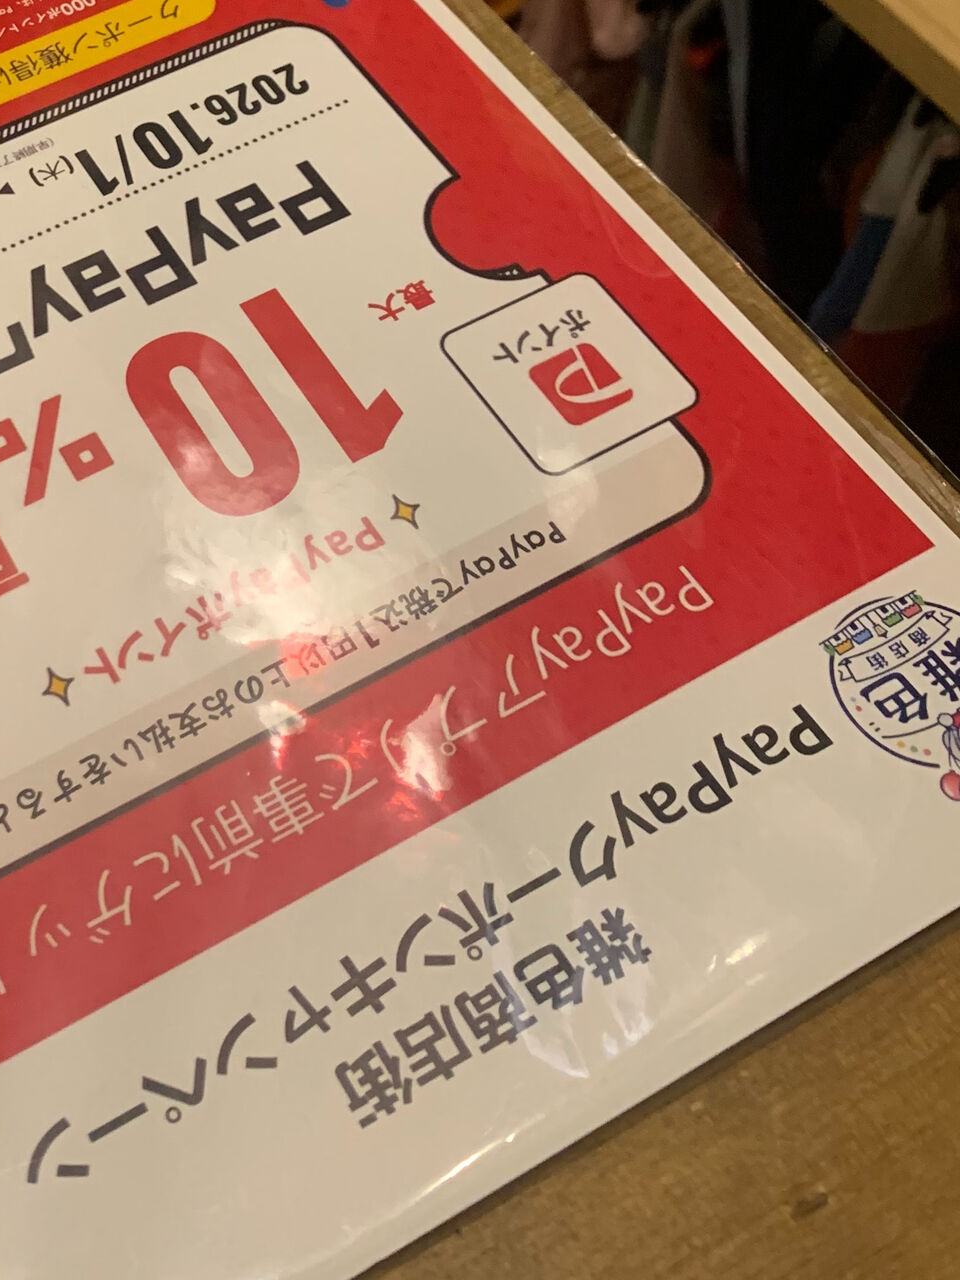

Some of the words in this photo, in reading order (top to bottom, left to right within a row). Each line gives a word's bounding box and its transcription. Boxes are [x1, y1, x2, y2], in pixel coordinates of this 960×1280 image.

[367, 278, 435, 320] 最大
[493, 305, 589, 363] ポイント
[82, 515, 385, 683] Payayポイント
[866, 627, 931, 671] 商店街
[29, 704, 832, 1185] PayPayクーポンキャンペーン
[331, 908, 653, 1129] 雑色商店街
